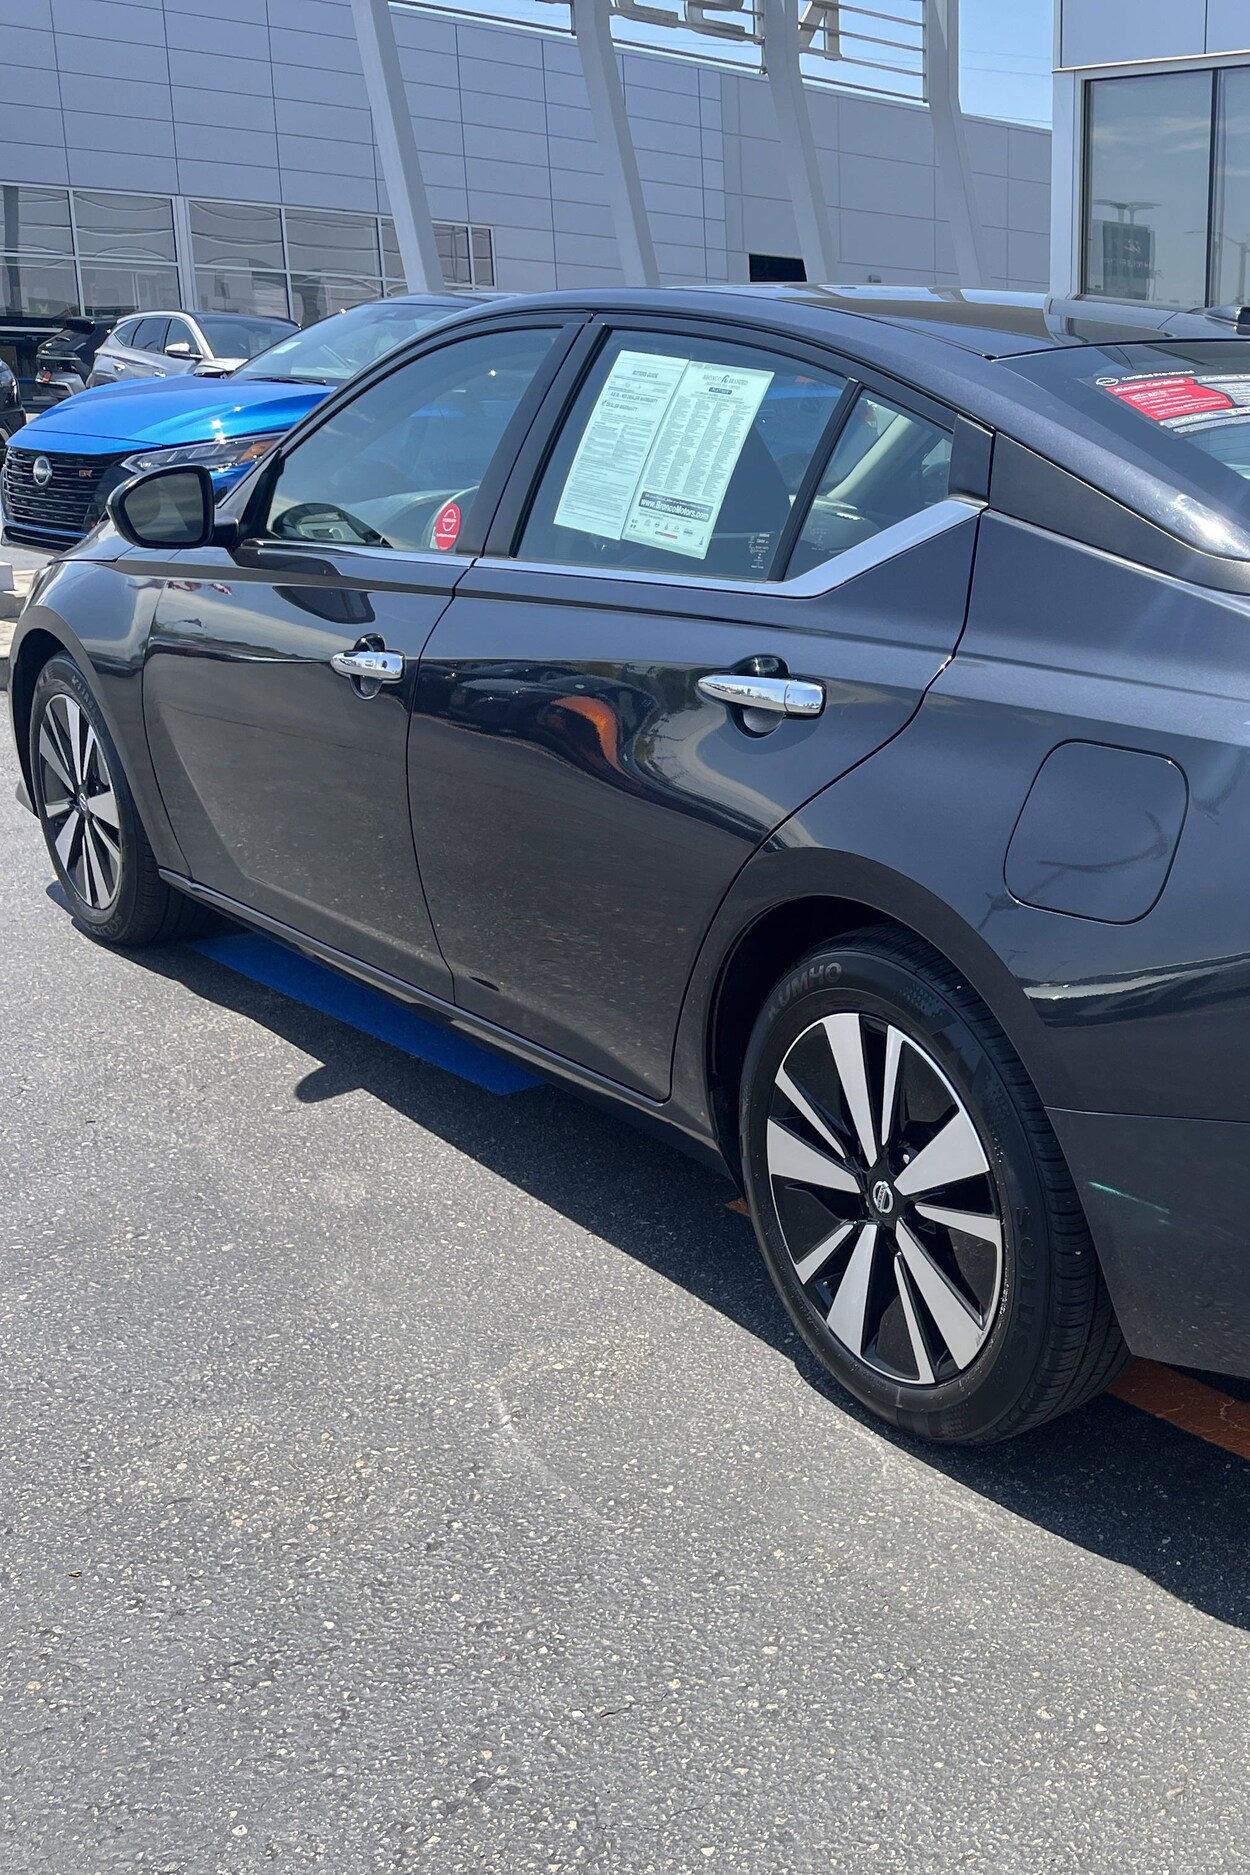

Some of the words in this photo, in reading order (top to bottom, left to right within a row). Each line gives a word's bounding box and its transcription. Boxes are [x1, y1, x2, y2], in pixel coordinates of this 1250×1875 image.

[1113, 384, 1146, 393] Nissan
[640, 498, 709, 520] www.BroncoMotors.com
[768, 962, 842, 1021] KUMHO
